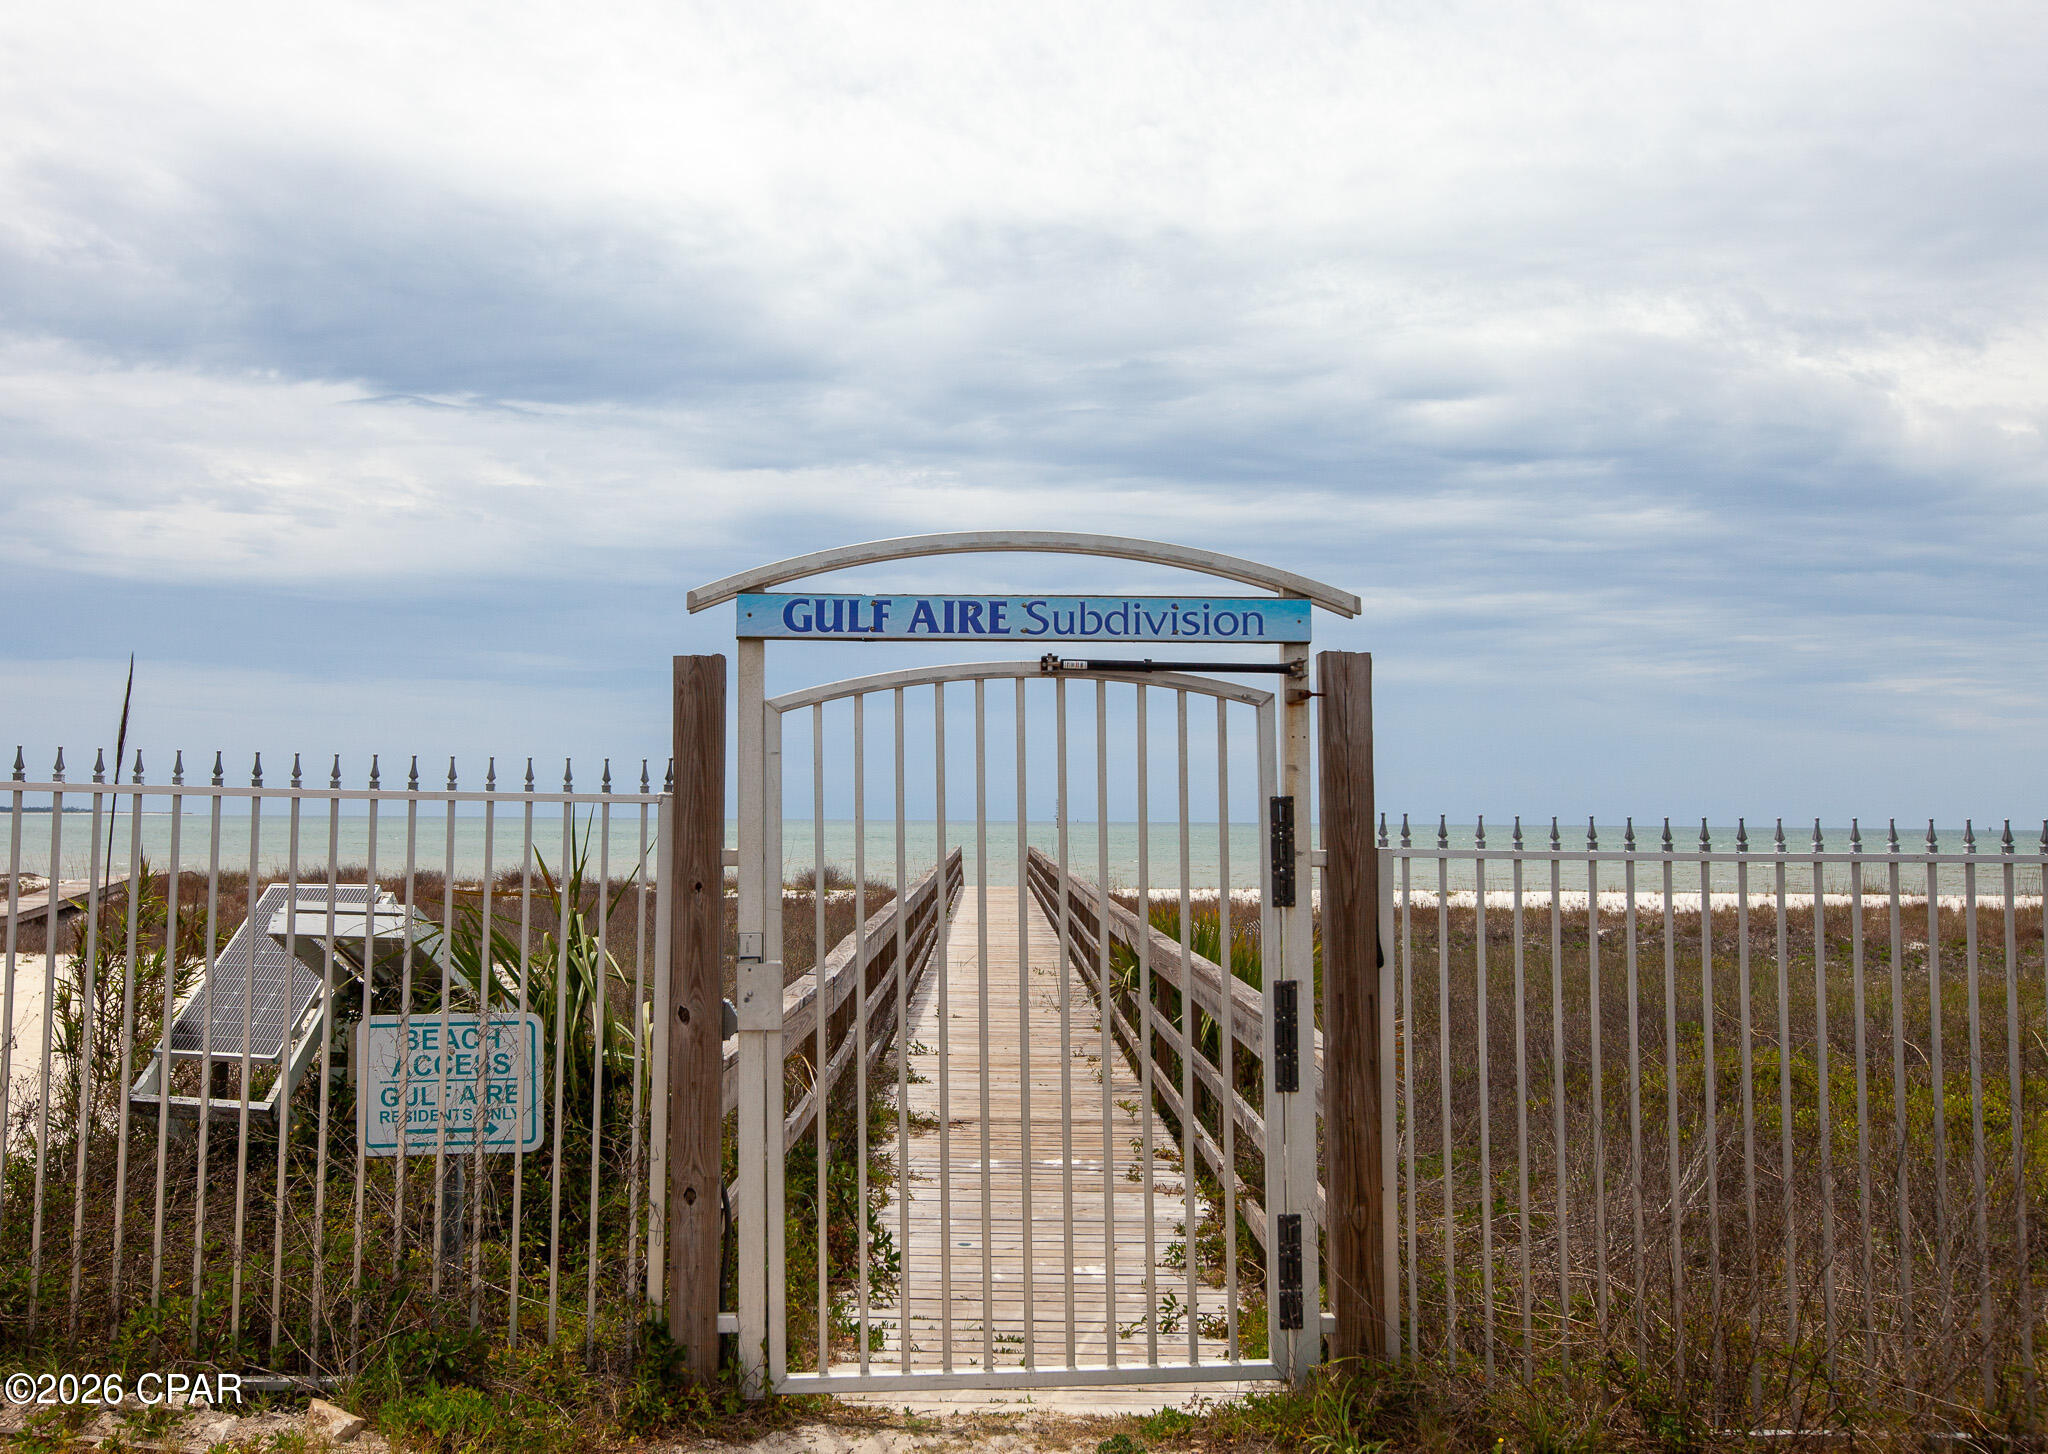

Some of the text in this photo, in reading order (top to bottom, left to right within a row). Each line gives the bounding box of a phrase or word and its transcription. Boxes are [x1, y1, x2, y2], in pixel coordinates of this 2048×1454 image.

[783, 599, 1265, 636] GULF AIRE Subdivision
[459, 1084, 518, 1105] ARE
